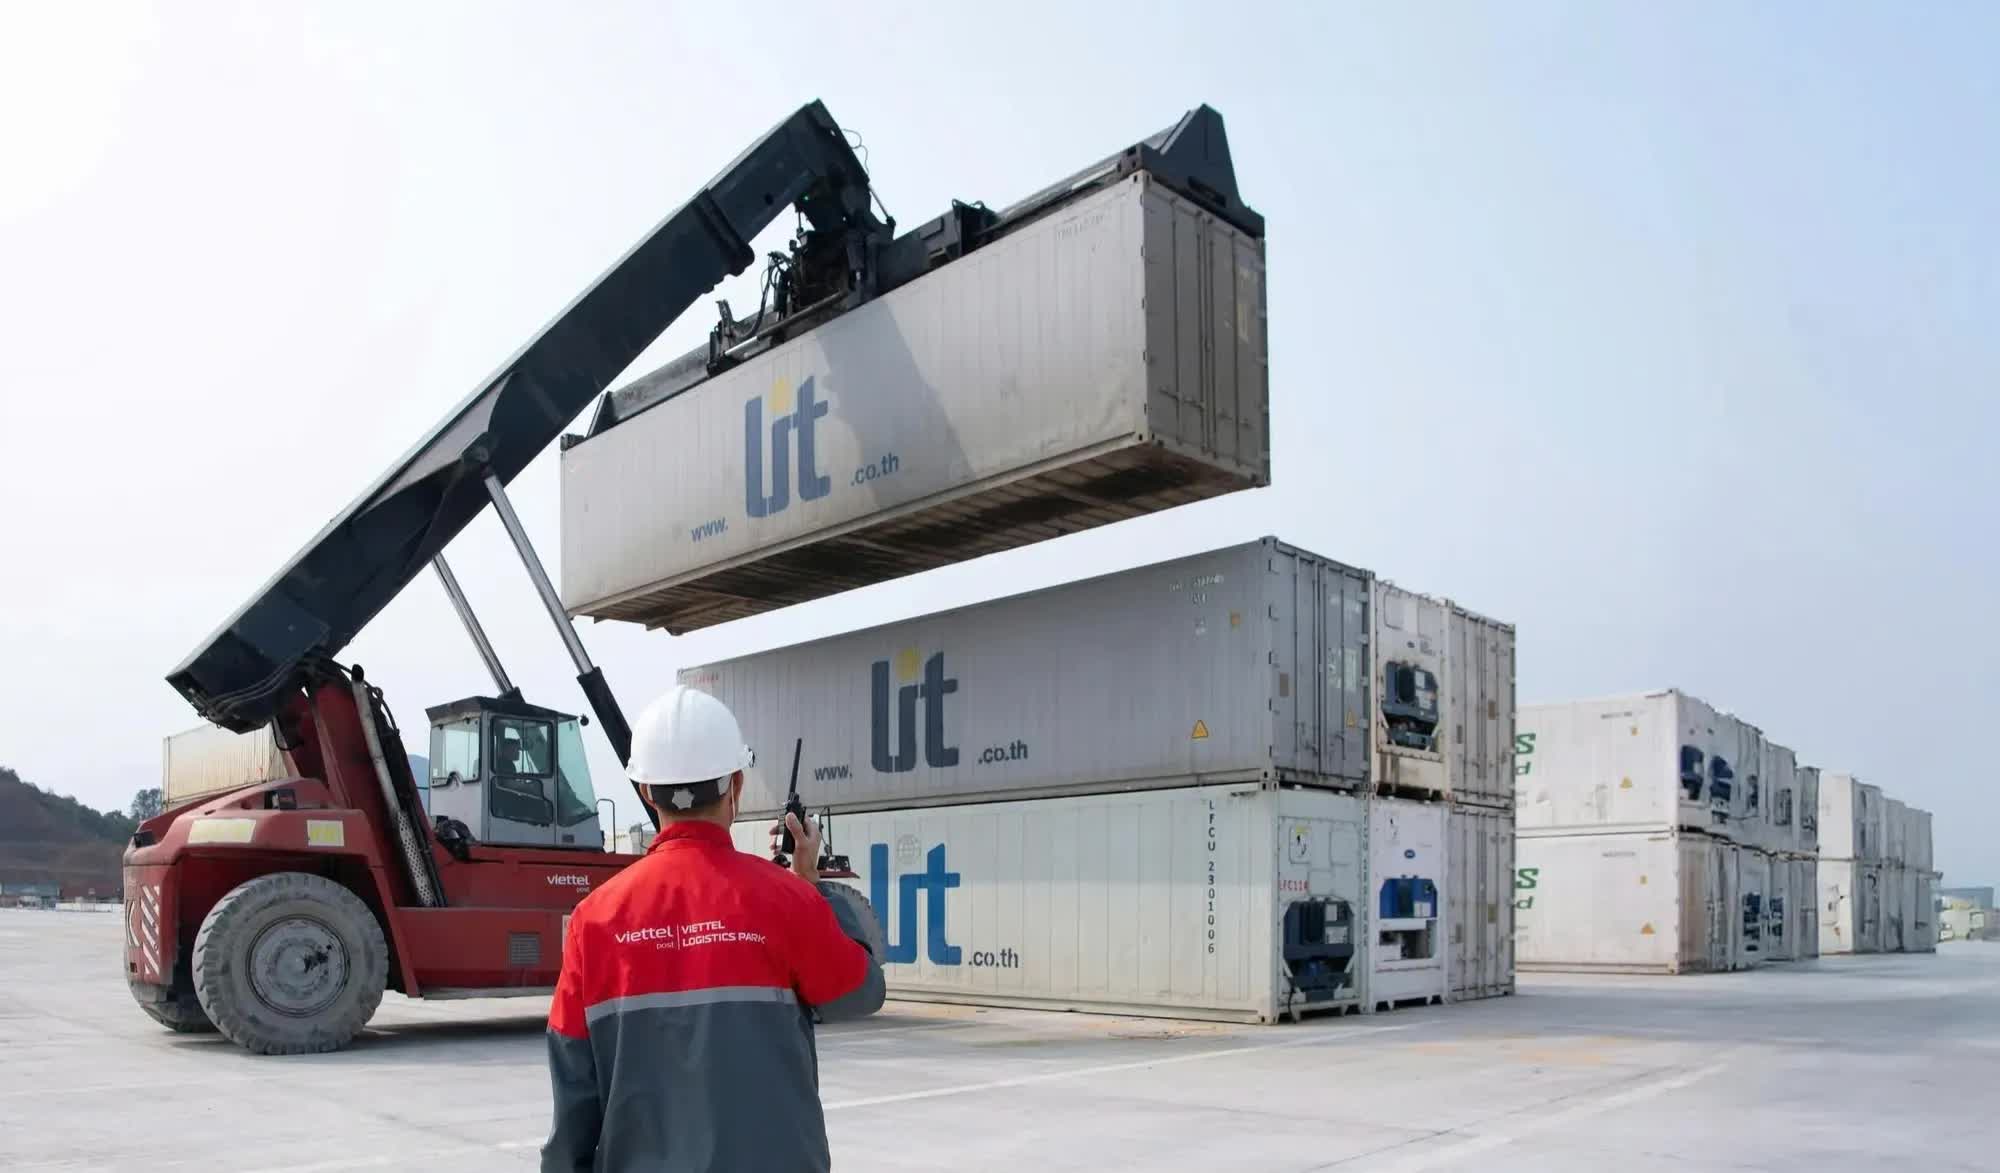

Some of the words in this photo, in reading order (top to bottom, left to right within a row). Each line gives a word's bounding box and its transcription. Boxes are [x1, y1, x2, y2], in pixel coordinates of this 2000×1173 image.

[690, 517, 729, 542] www.
[850, 452, 899, 486] .co.th
[814, 764, 853, 781] www.
[977, 740, 1028, 765] .co.th
[1207, 799, 1216, 851] LFCU
[546, 874, 591, 886] viettel
[1207, 861, 1216, 954] 2301006
[615, 925, 674, 944] viettel
[681, 920, 725, 934] VIETTEL
[656, 941, 674, 950] post
[682, 931, 736, 948] LOGISTICS
[738, 931, 766, 945] PARK
[968, 948, 1019, 968] .co.th
